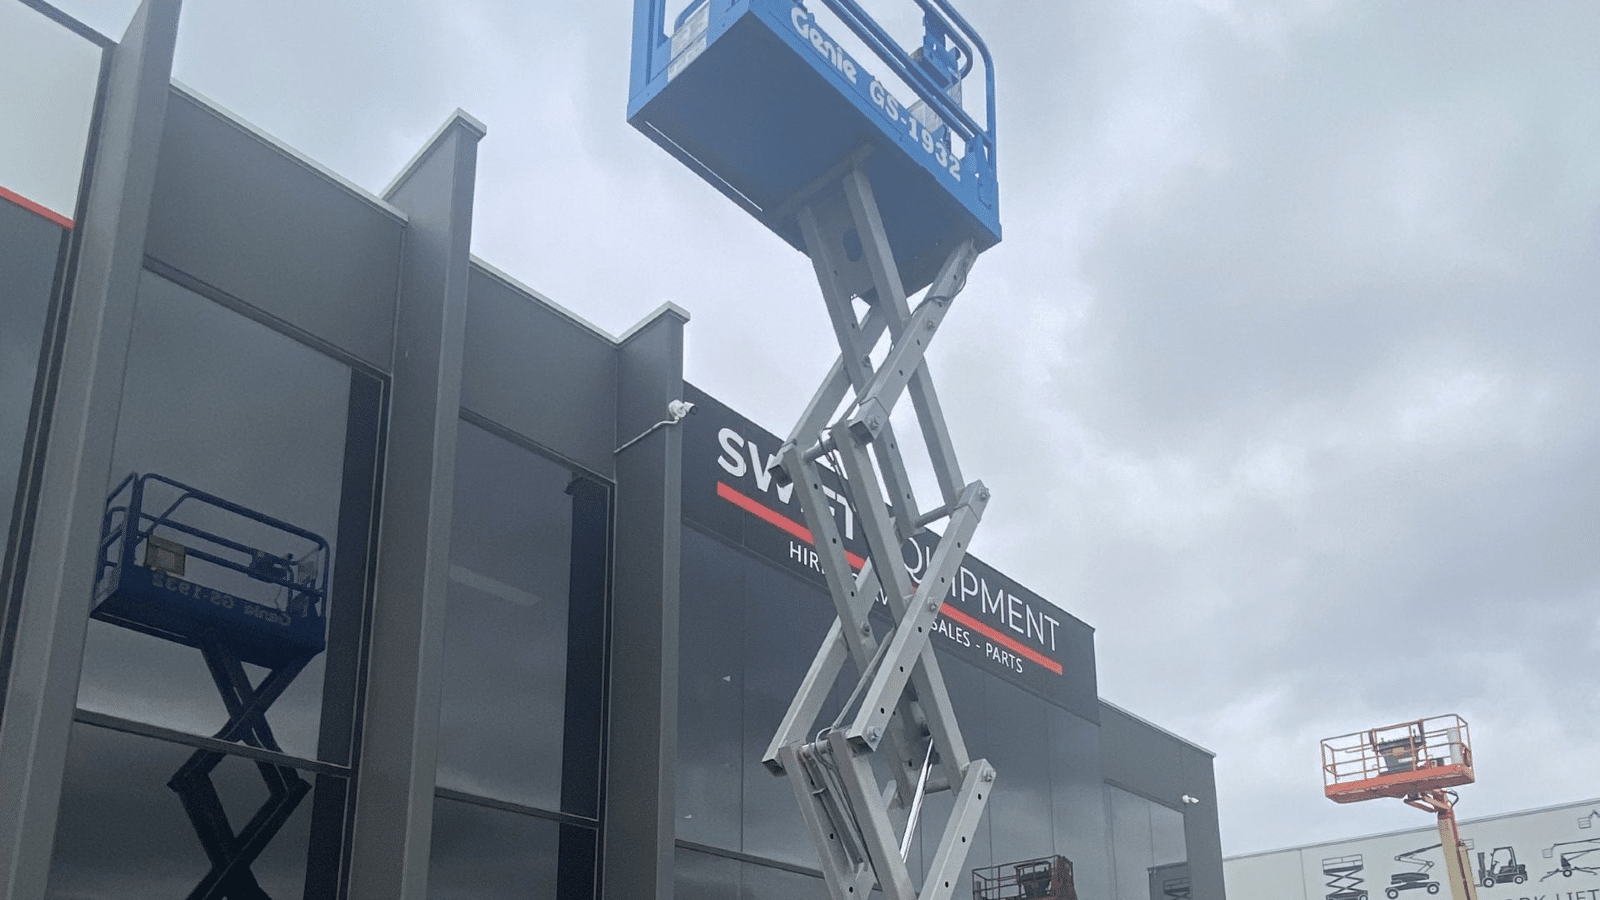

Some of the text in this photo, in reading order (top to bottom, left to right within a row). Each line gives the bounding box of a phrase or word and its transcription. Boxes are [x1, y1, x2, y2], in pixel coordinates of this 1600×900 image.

[791, 7, 961, 182] Genie GS-1932
[789, 541, 825, 574] HIR
[985, 642, 1023, 673] PARTS
